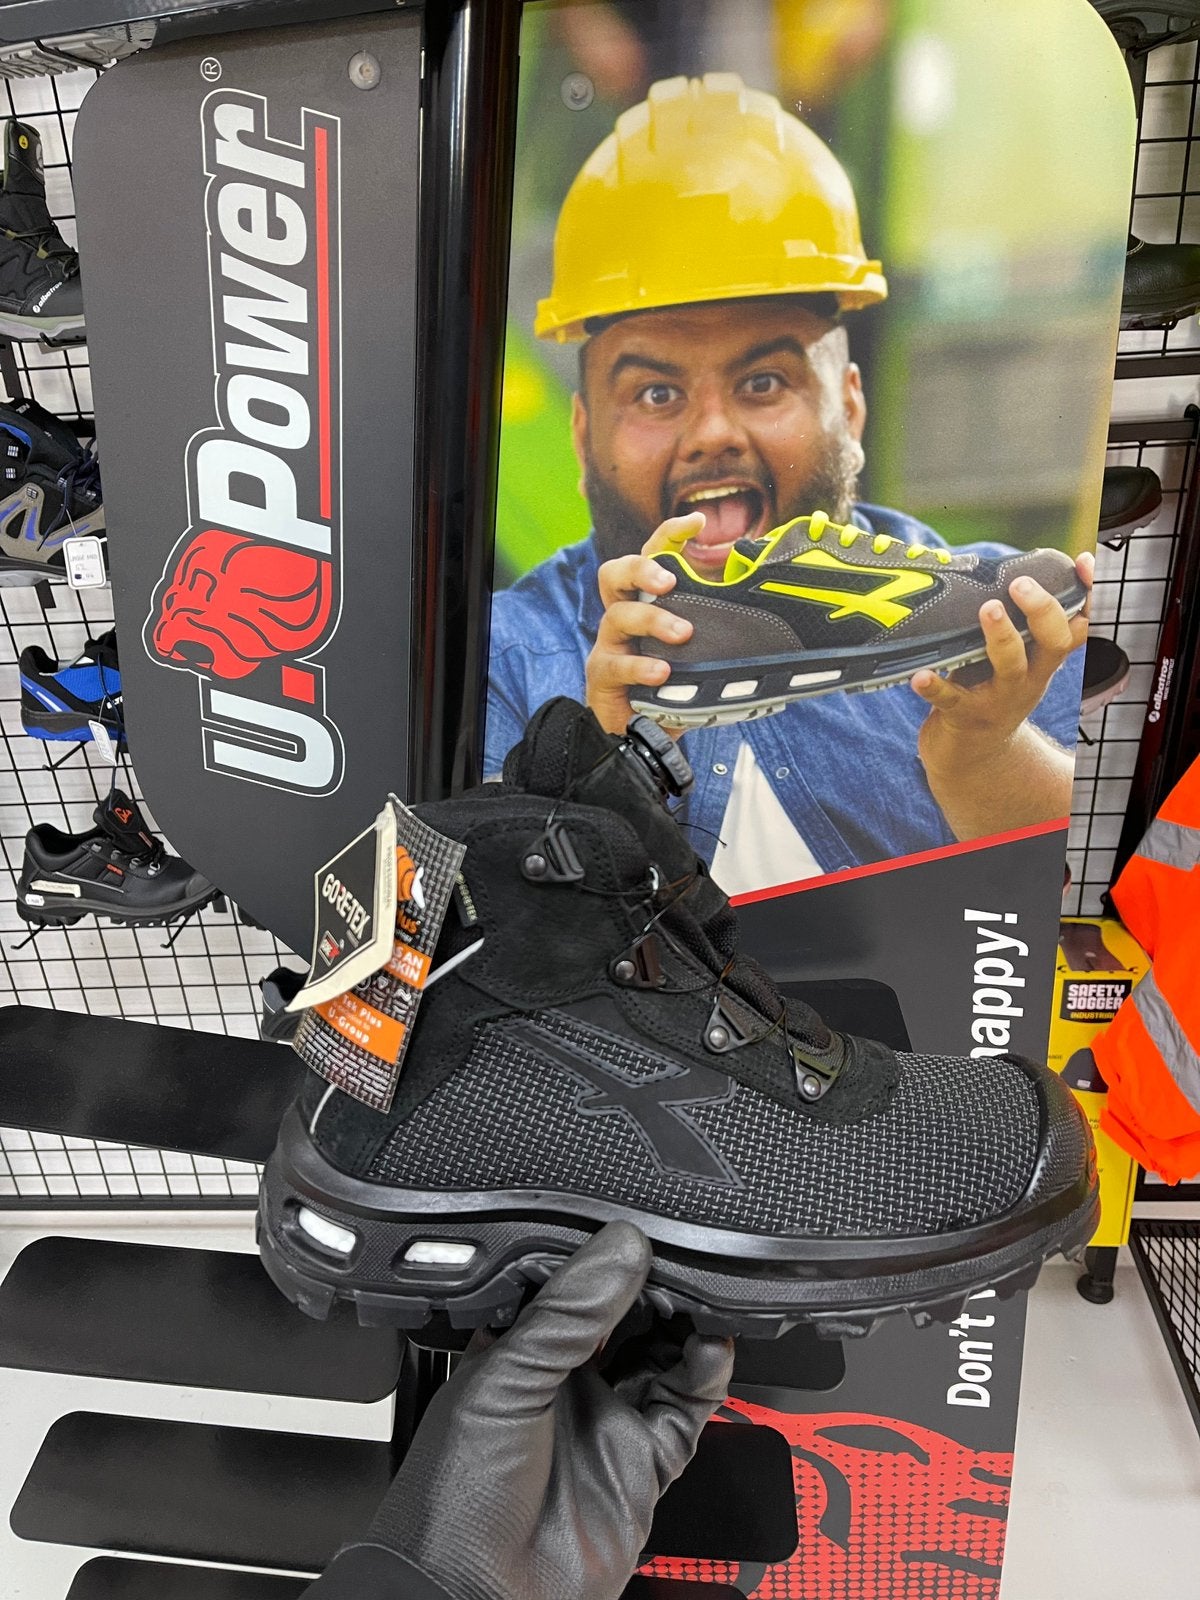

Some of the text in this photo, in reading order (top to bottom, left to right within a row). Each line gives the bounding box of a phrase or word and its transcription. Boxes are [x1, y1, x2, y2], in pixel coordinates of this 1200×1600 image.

[1153, 656, 1169, 710] albatros
[403, 951, 425, 970] AN
[1068, 983, 1126, 997] SAFETY
[1066, 996, 1123, 1010] JOGGER
[946, 1312, 996, 1409] Don't
